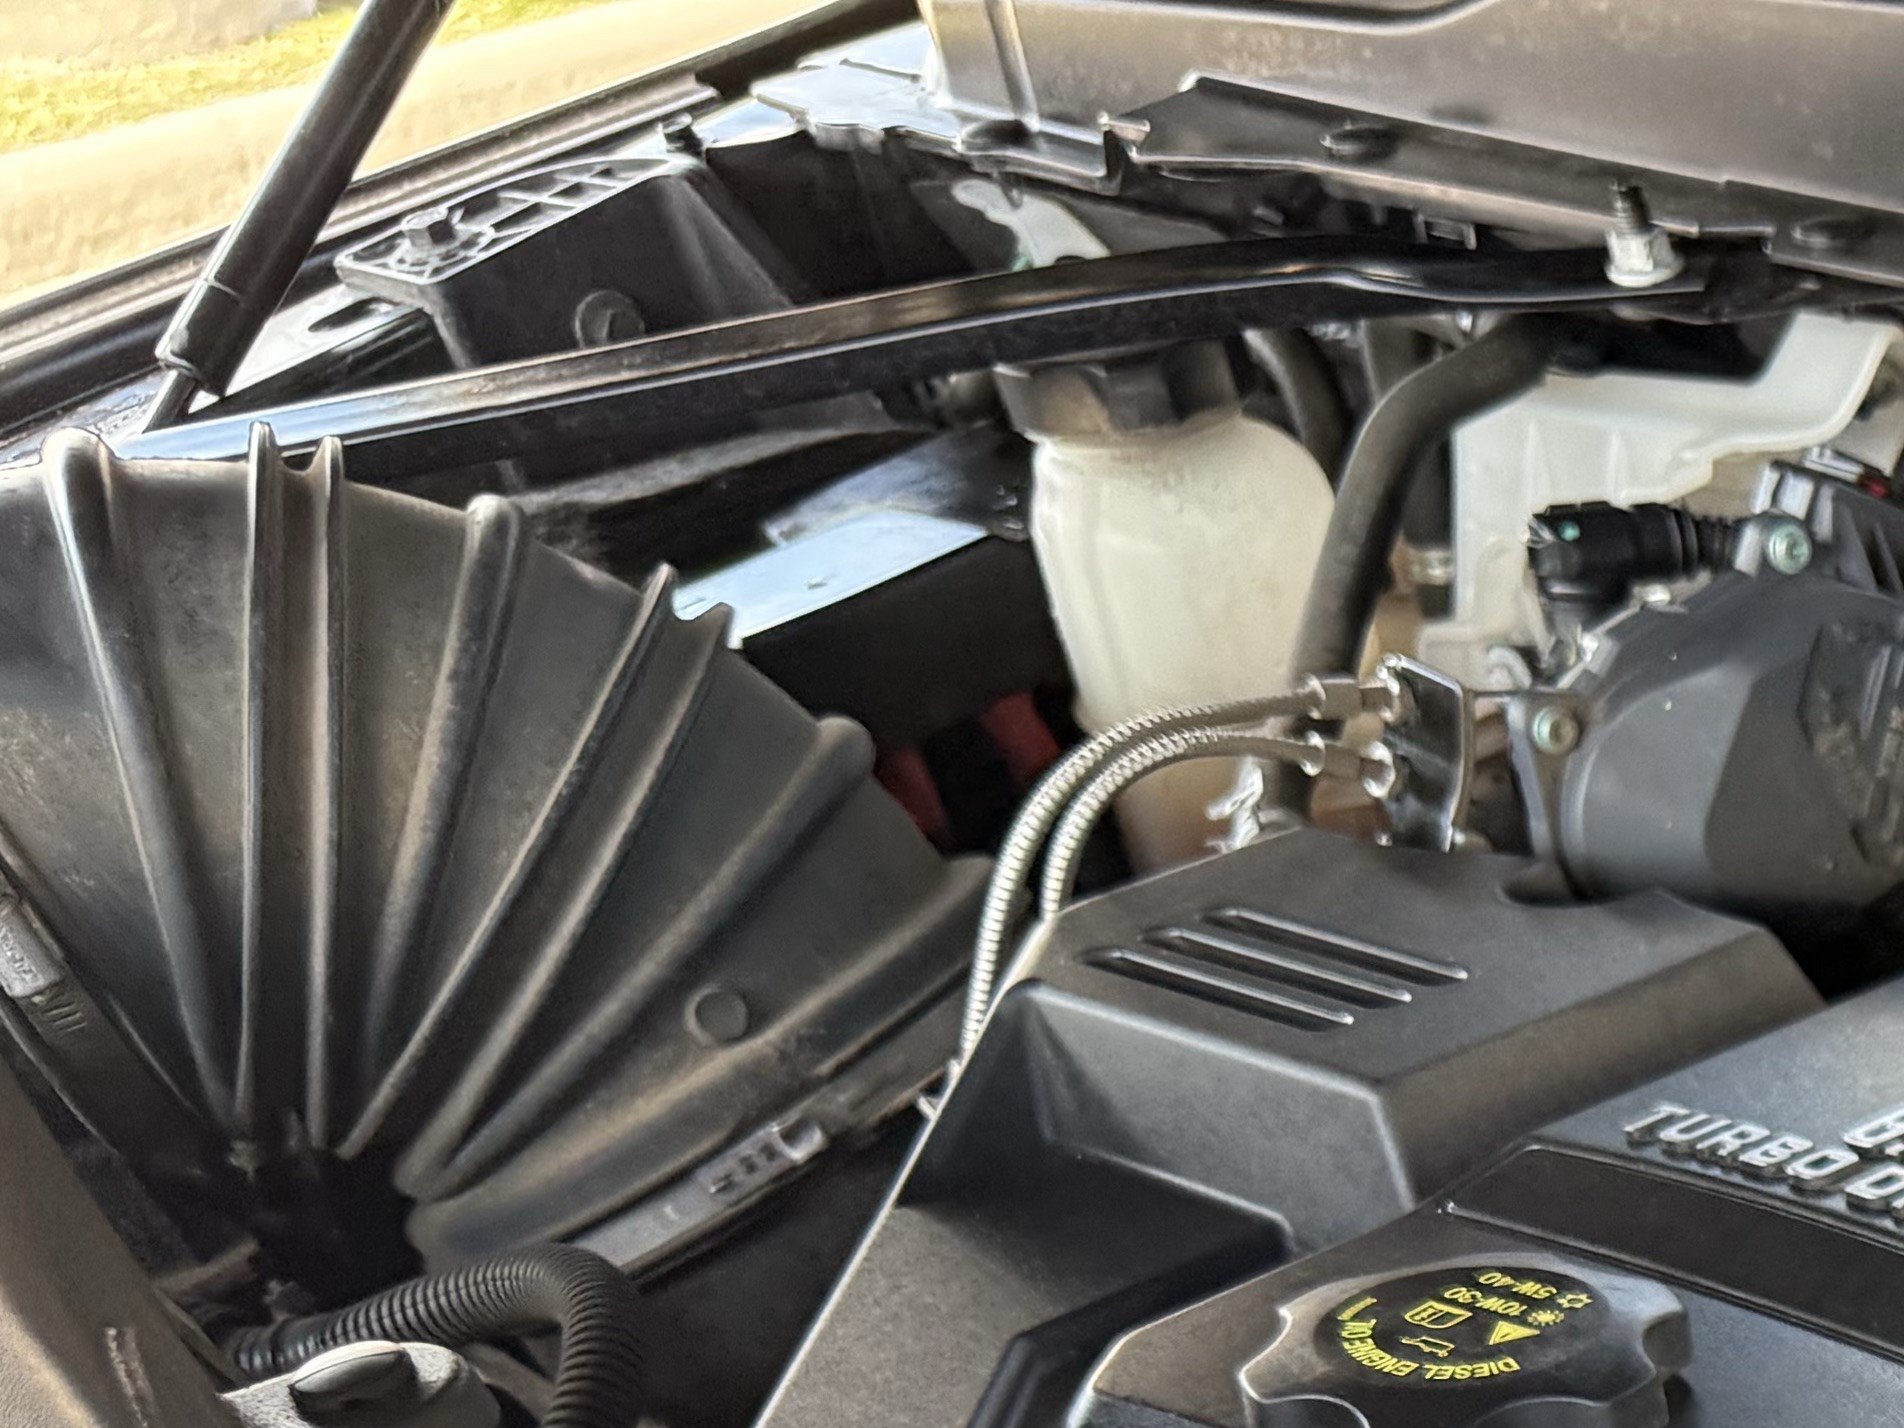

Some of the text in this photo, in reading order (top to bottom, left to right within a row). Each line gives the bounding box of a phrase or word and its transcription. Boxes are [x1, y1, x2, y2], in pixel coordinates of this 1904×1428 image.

[1621, 1102, 1861, 1192] TURBO
[1478, 1272, 1557, 1299] 5W-40
[1444, 1287, 1528, 1316] 10W-30
[1343, 1338, 1419, 1377] ENGINE
[1422, 1357, 1521, 1380] DIESEL
